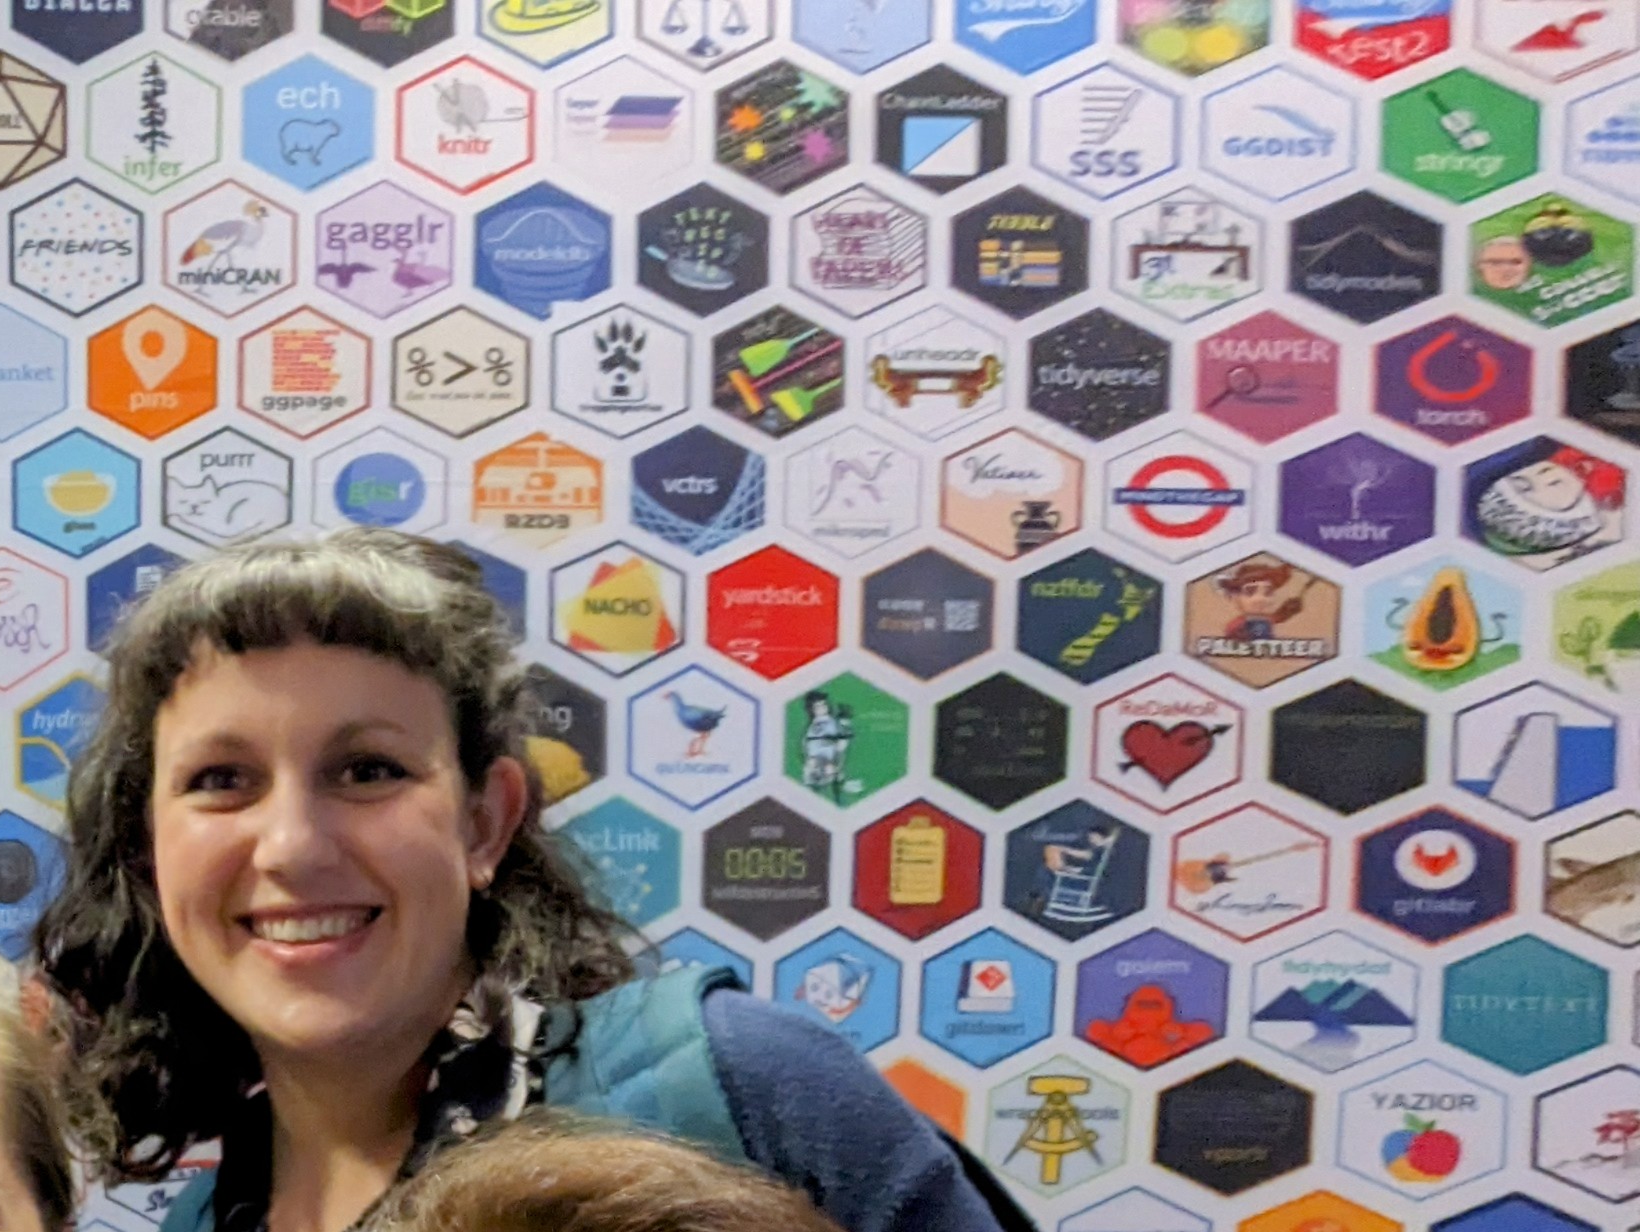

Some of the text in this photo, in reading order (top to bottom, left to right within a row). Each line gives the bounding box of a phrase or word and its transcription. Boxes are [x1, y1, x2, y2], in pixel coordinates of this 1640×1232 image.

[275, 81, 342, 110] ech
[437, 133, 494, 155] knitr
[1222, 135, 1335, 157] GGDIST
[123, 156, 183, 183] infer
[1068, 150, 1143, 178] SSS
[325, 213, 444, 251] gagglr
[18, 237, 134, 257] FRIENDS
[177, 267, 282, 286] miniCRAN
[893, 347, 982, 364] unheadr
[1208, 339, 1332, 364] MAAPER
[1037, 362, 1158, 387] tidyverse
[129, 388, 179, 411] pins
[261, 393, 348, 411] ggpage
[199, 450, 256, 472] purrr
[662, 475, 720, 496] vctrs
[1318, 521, 1392, 543] withr
[722, 585, 823, 607] yardstick
[1370, 1092, 1478, 1112] YAZIOR
